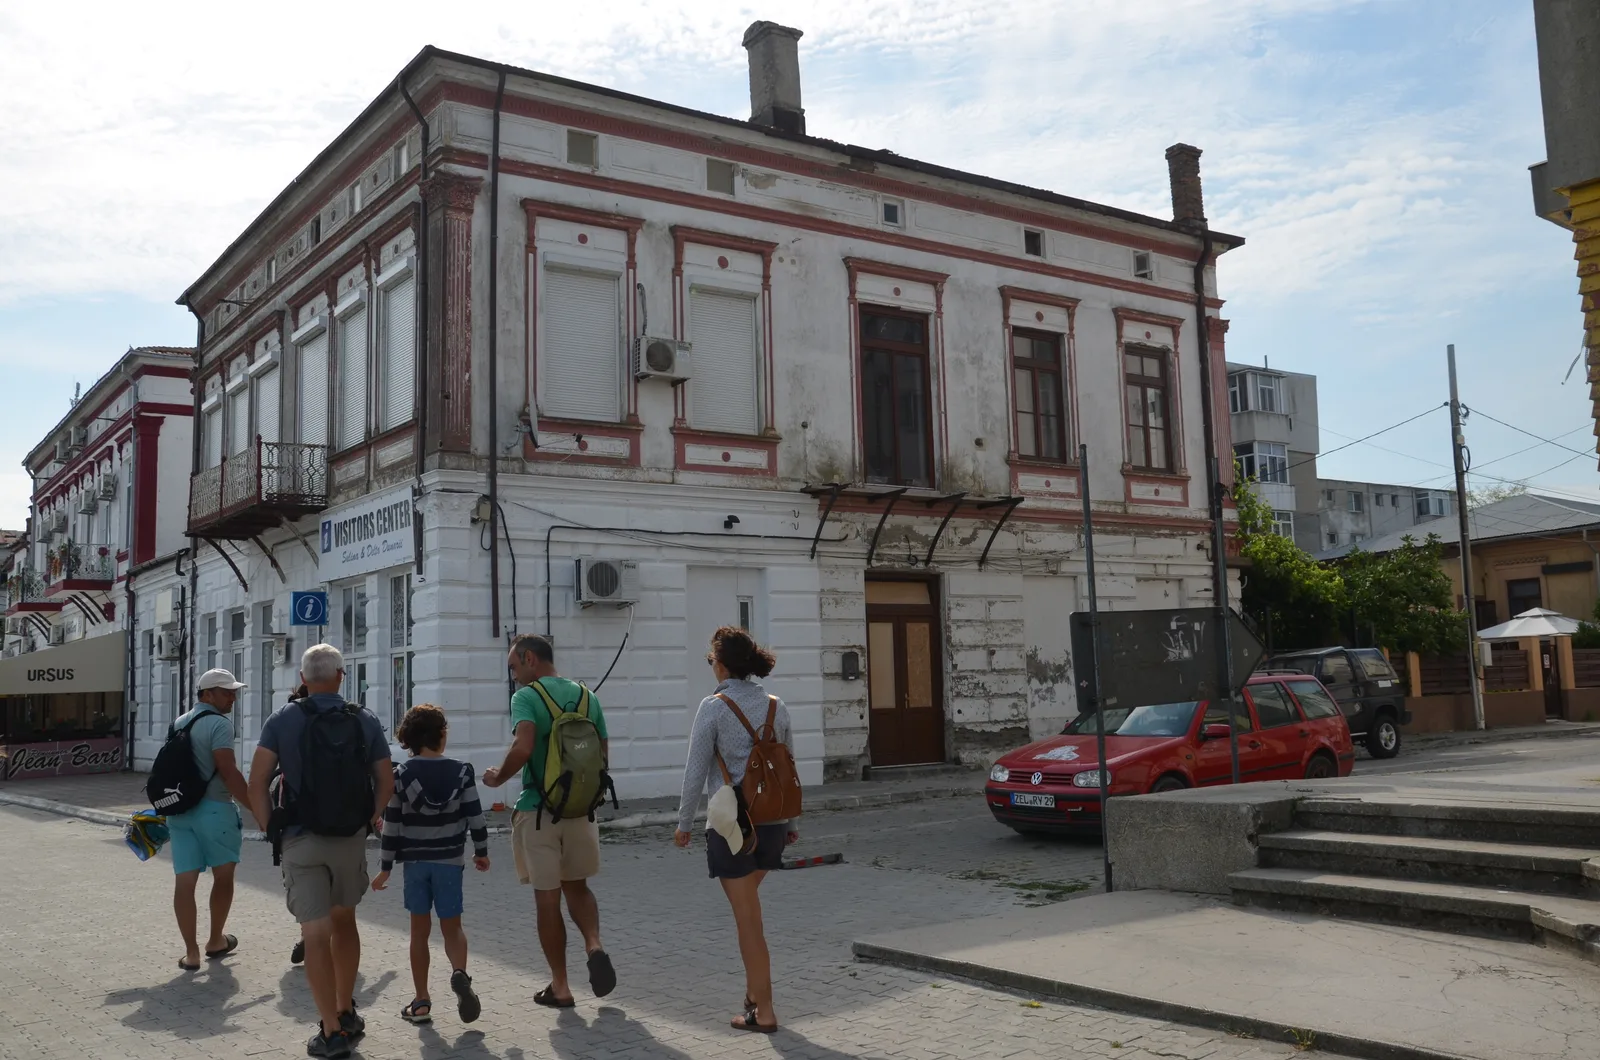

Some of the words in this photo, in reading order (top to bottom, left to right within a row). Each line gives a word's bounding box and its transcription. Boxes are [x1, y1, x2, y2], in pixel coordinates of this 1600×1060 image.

[334, 511, 375, 548] VISITORS
[376, 499, 411, 536] CENTER
[360, 546, 365, 559] &
[27, 667, 75, 682] URSUS
[8, 747, 62, 778] Jean
[70, 743, 120, 766] Bart
[154, 793, 180, 809] PUMA
[1044, 796, 1054, 806] 29
